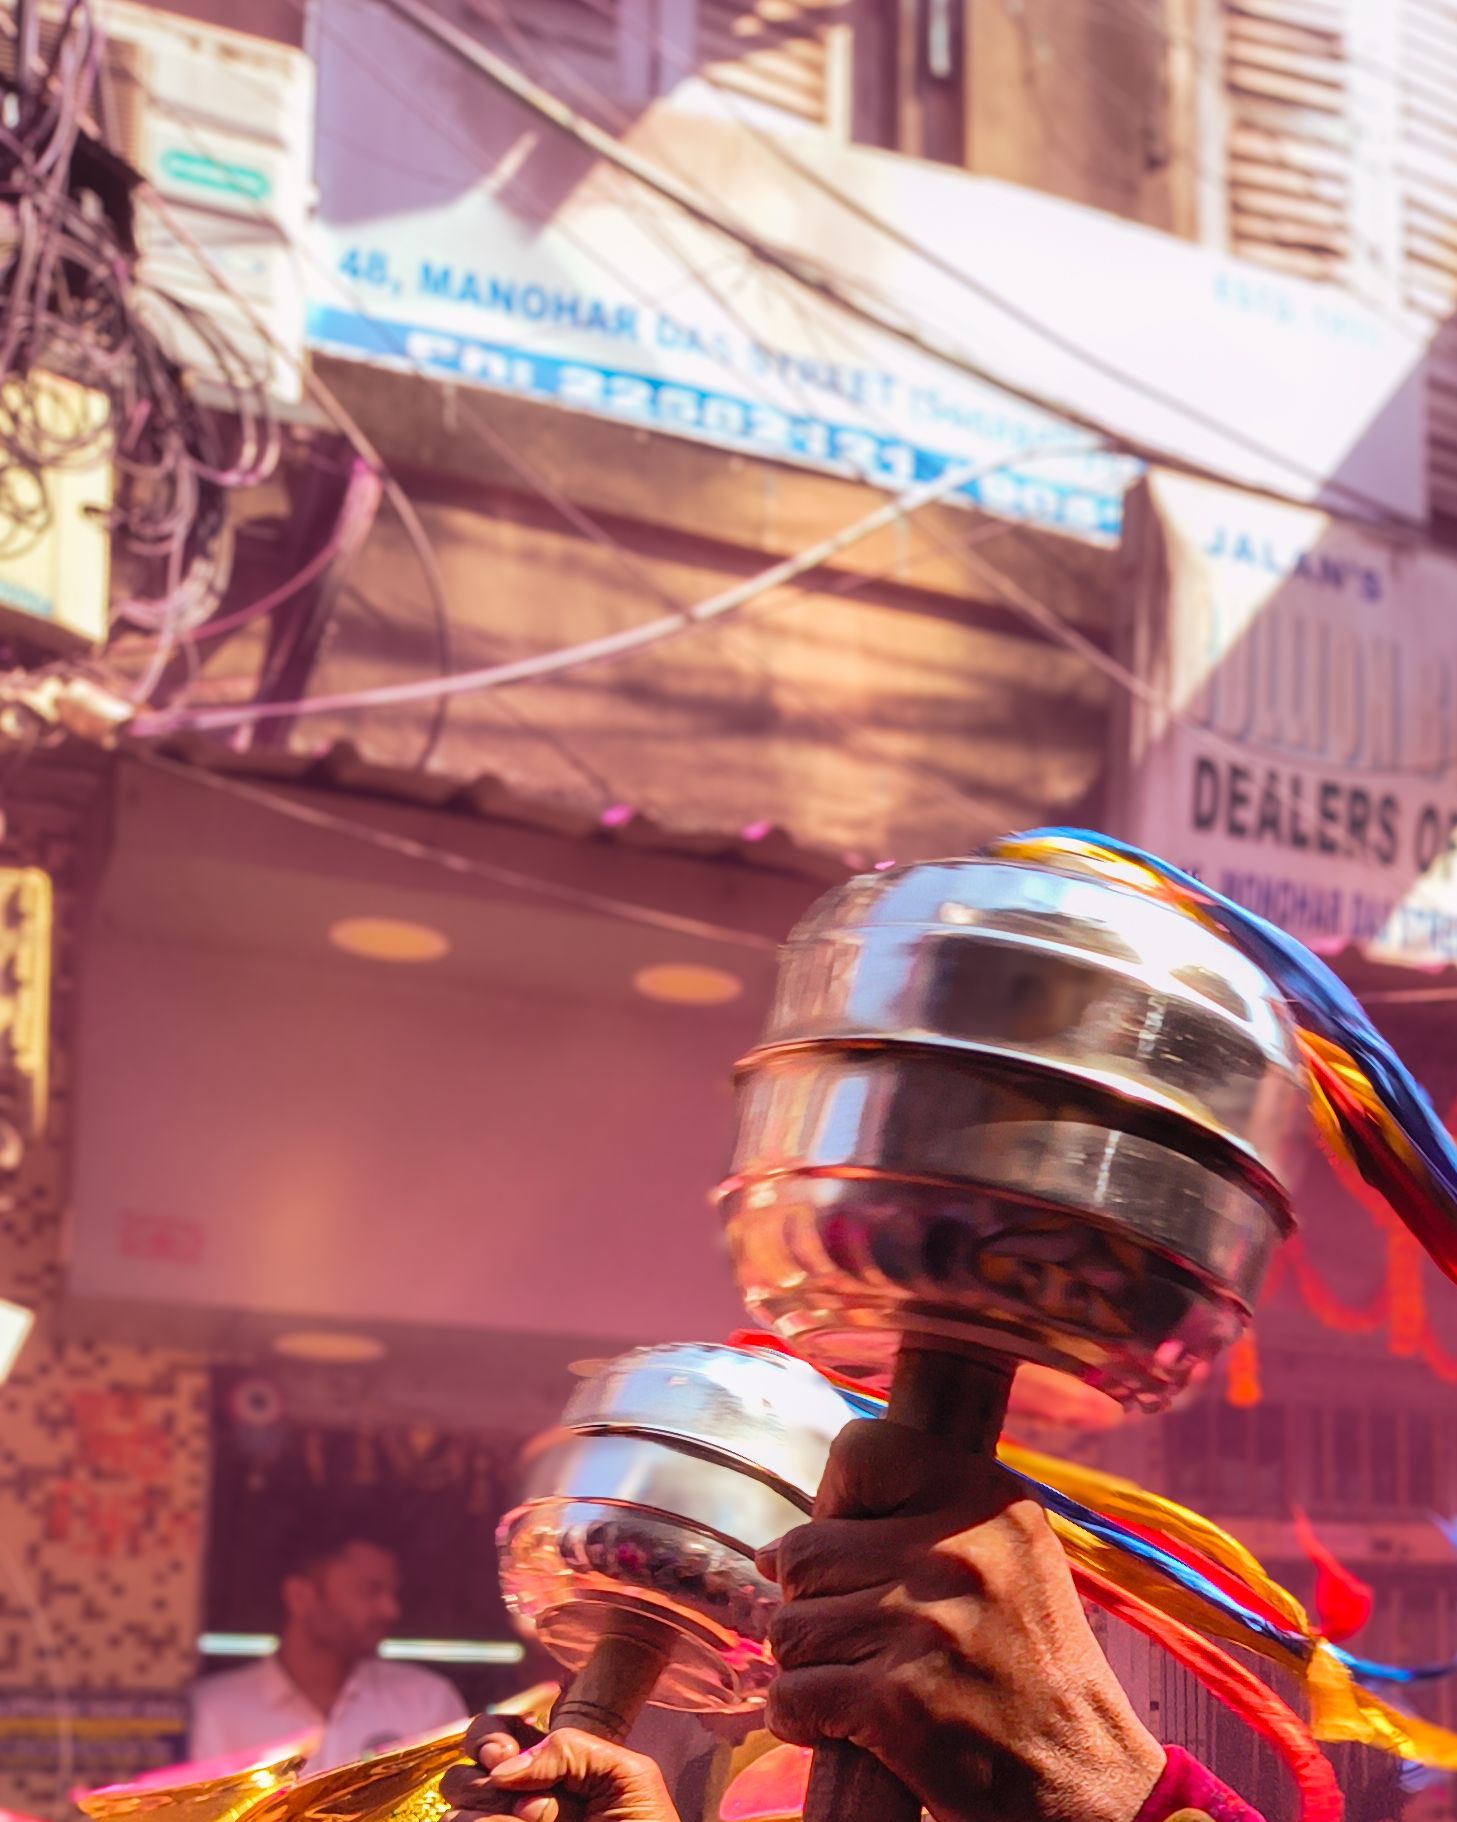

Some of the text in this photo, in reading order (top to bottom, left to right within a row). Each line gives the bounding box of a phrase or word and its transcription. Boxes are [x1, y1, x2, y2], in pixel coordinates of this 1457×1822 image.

[420, 260, 638, 344] MANOHAR
[1203, 524, 1385, 604] JALAN'S
[1193, 759, 1400, 874] DEALERS
